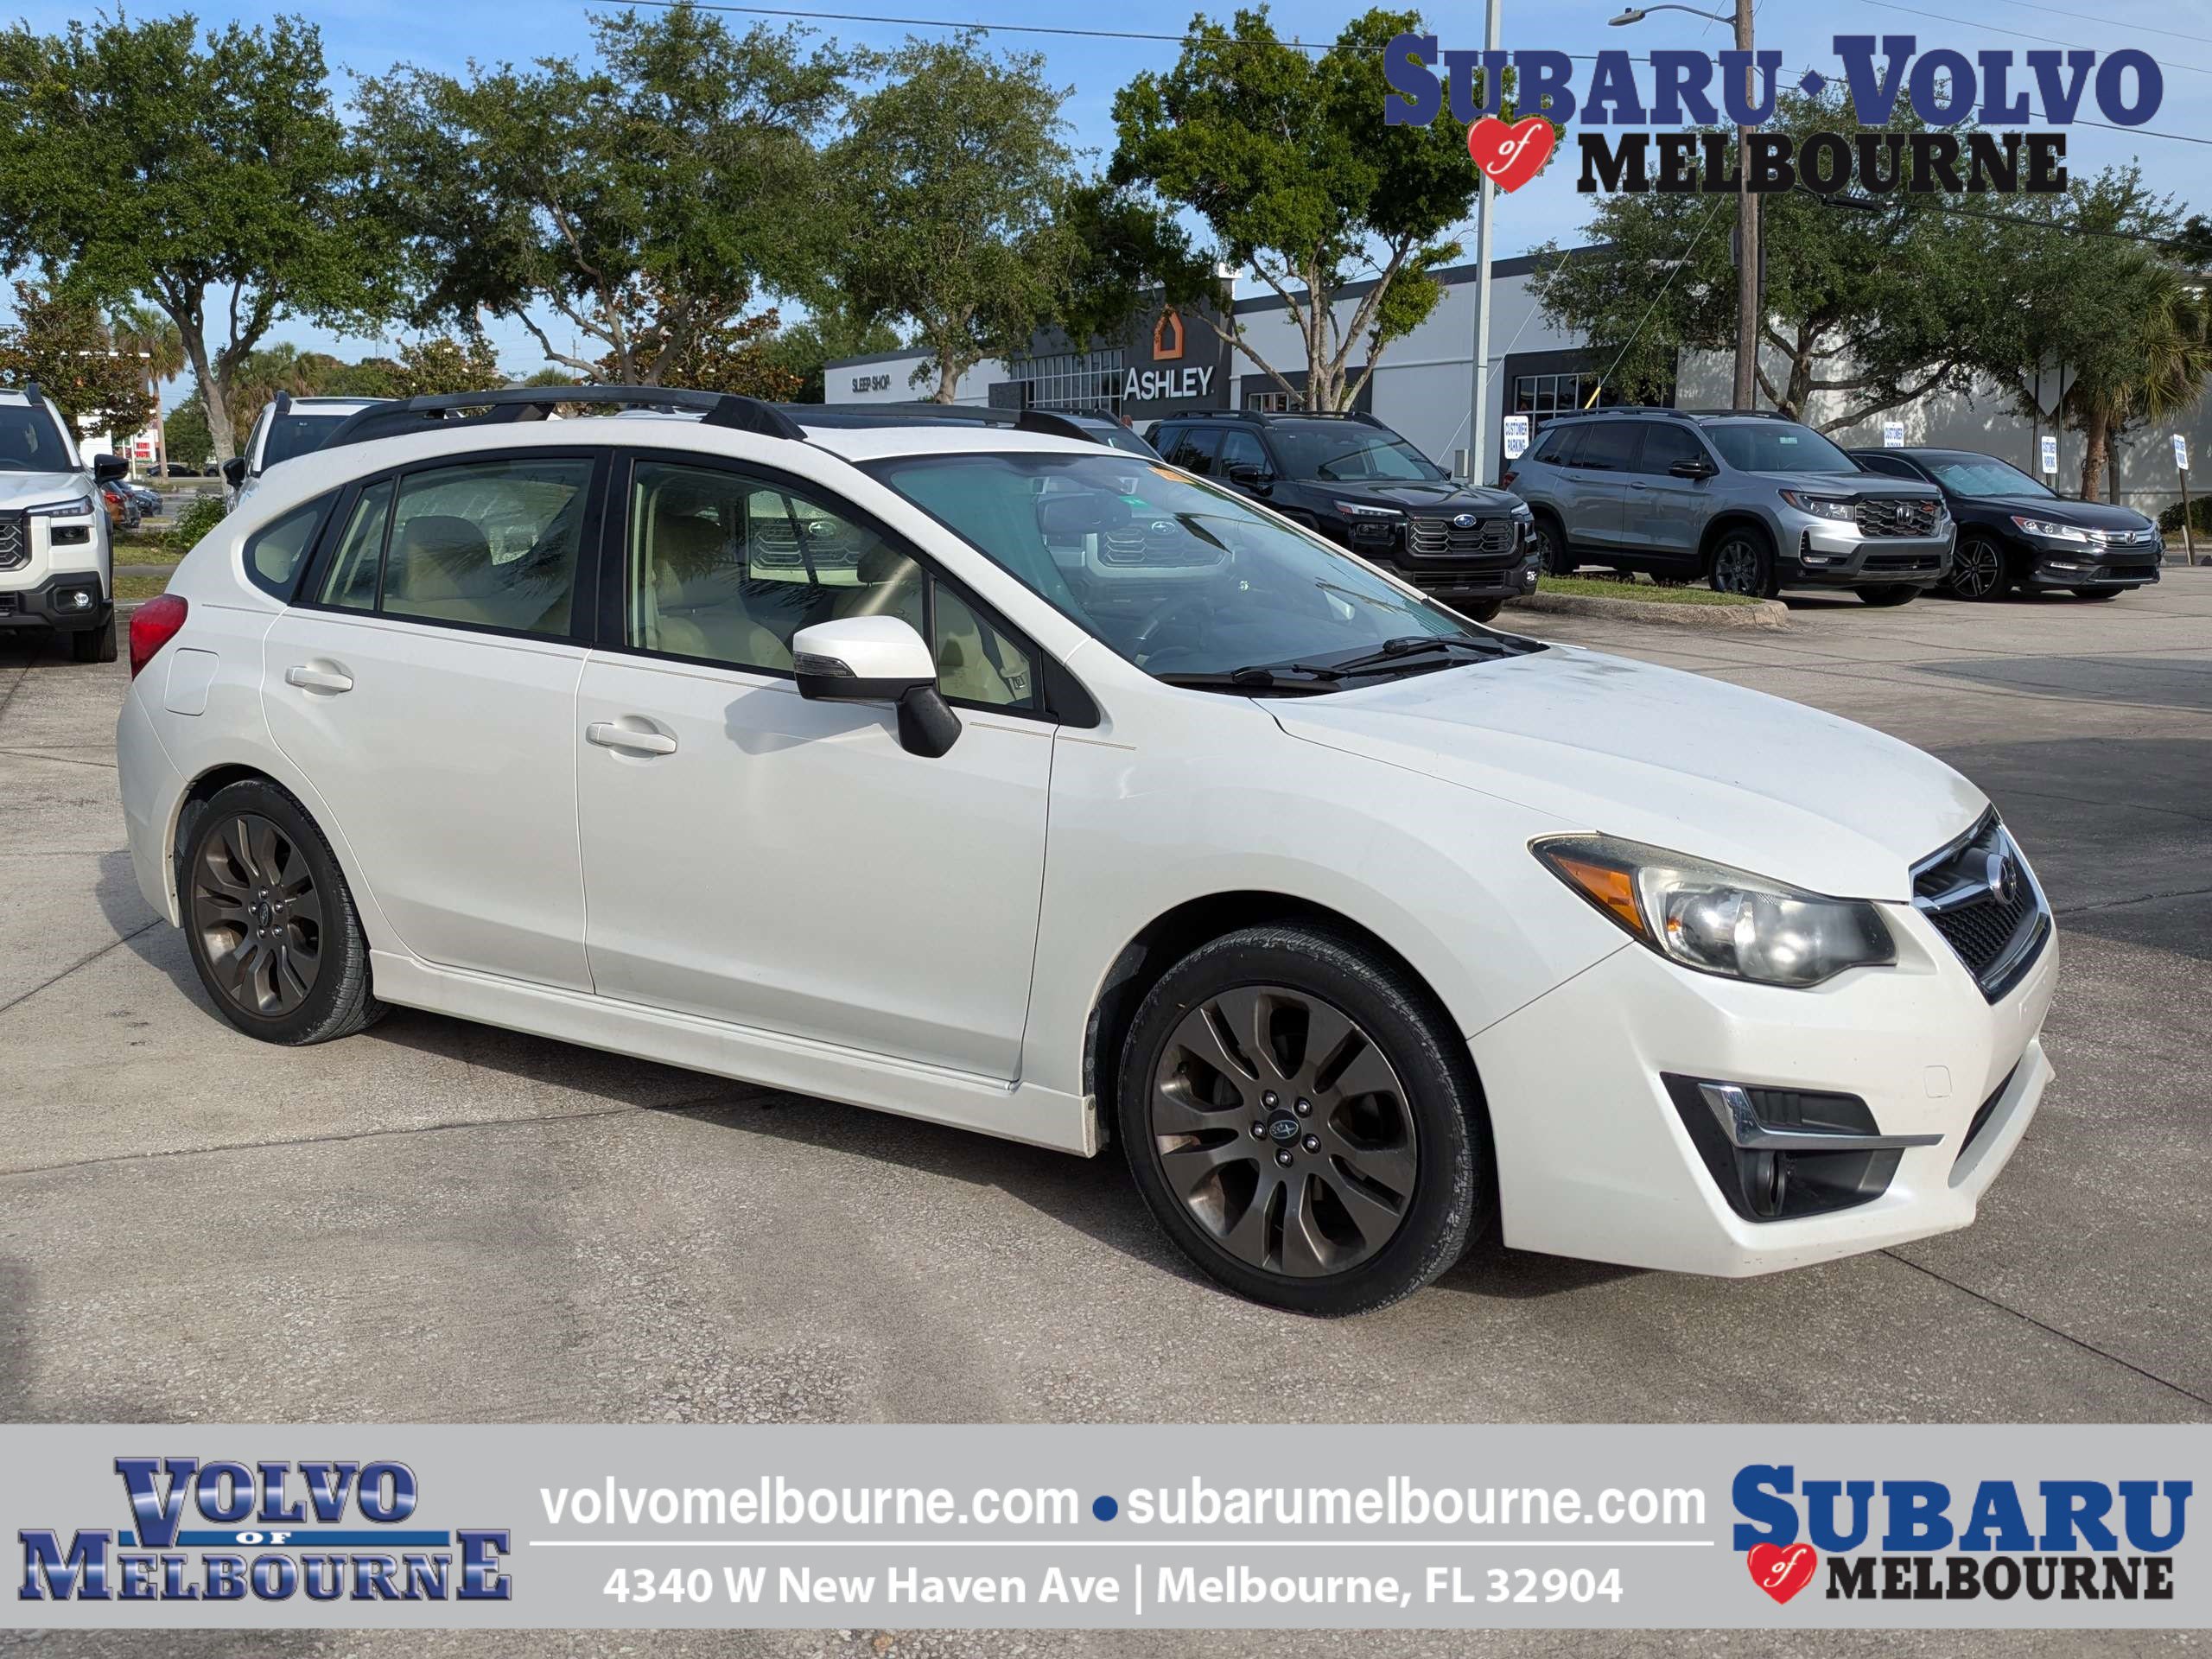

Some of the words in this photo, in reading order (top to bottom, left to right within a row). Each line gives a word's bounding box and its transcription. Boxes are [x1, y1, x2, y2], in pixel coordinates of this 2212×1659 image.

[852, 377, 871, 393] SLEEP
[872, 374, 890, 391] SHOP
[1123, 365, 1213, 400] ASHLEY
[1505, 422, 1528, 435] CUSTOMER
